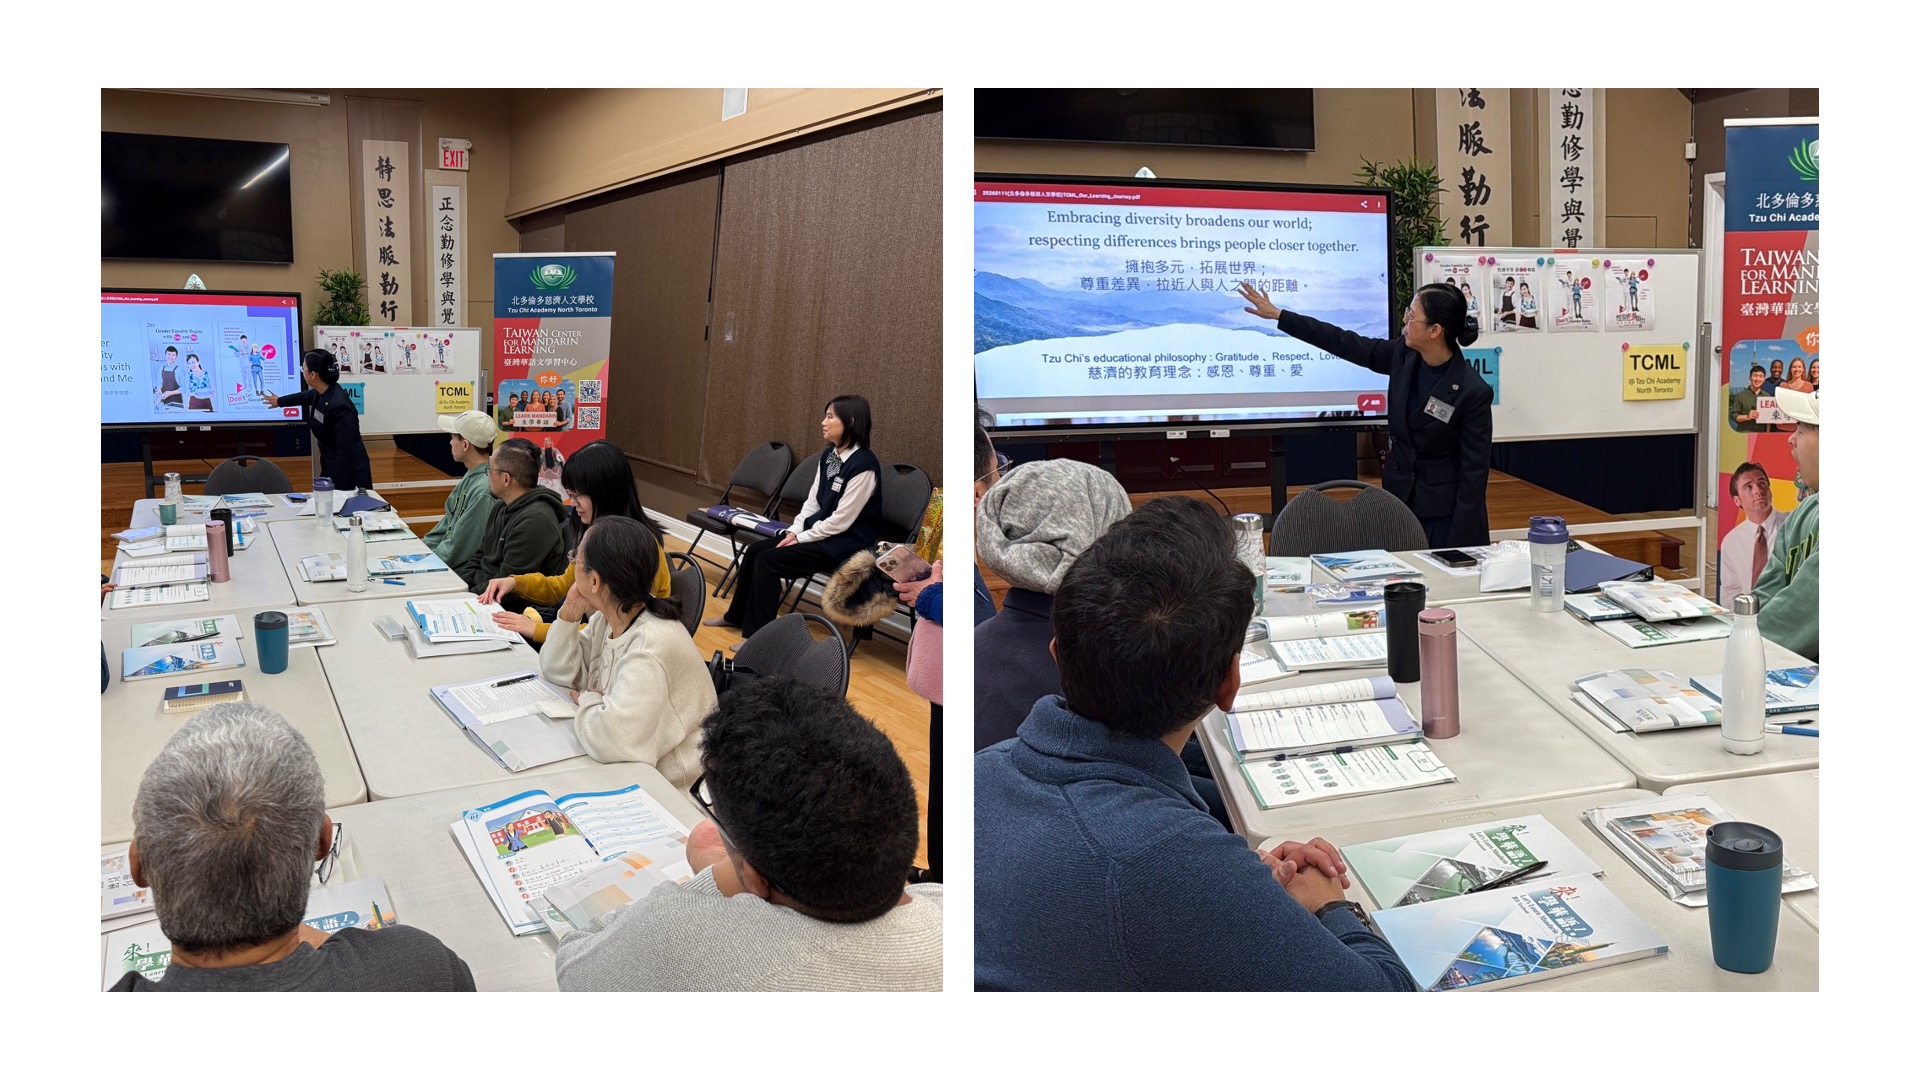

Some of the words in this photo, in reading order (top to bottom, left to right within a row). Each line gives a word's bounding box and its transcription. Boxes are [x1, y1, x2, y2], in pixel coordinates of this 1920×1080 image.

[443, 149, 465, 168] EXIT
[1047, 210, 1122, 227] Embracing
[1125, 212, 1182, 229] diversity
[1186, 214, 1245, 228] broadens
[1248, 218, 1270, 228] our
[1272, 217, 1313, 231] world;
[1748, 213, 1767, 222] Tzu
[1769, 213, 1786, 222] Chi
[1028, 234, 1100, 249] respecting
[1103, 234, 1177, 248] differences
[1180, 237, 1221, 252] brings
[1224, 239, 1266, 253] people
[1269, 238, 1306, 251] closer
[1307, 240, 1359, 254] together.
[439, 197, 455, 324] 正念勤修學與覺
[1740, 269, 1767, 281] FOR
[1770, 264, 1819, 280] MAN
[511, 294, 595, 306] 北多倫多慈濟人文學校
[503, 327, 550, 338] TAIWAN
[551, 329, 582, 338] CENTER
[520, 337, 579, 346] MANDARIN
[503, 345, 556, 355] LEARNING
[1041, 353, 1062, 363] Tzu
[1064, 353, 1091, 363] Chi's
[1093, 353, 1151, 362] educational
[1154, 352, 1207, 364] philosophy
[1215, 352, 1259, 362] Gratitude
[1629, 353, 1680, 371] TCML
[110, 362, 131, 371] with
[117, 374, 133, 383] Me
[539, 375, 558, 384] 你好
[1656, 377, 1681, 386] Academy
[440, 387, 470, 397] TCML
[1653, 386, 1674, 394] Toronto
[1520, 894, 1531, 904] Let's
[1528, 902, 1541, 916] Learn
[1540, 915, 1559, 934] Mandarin
